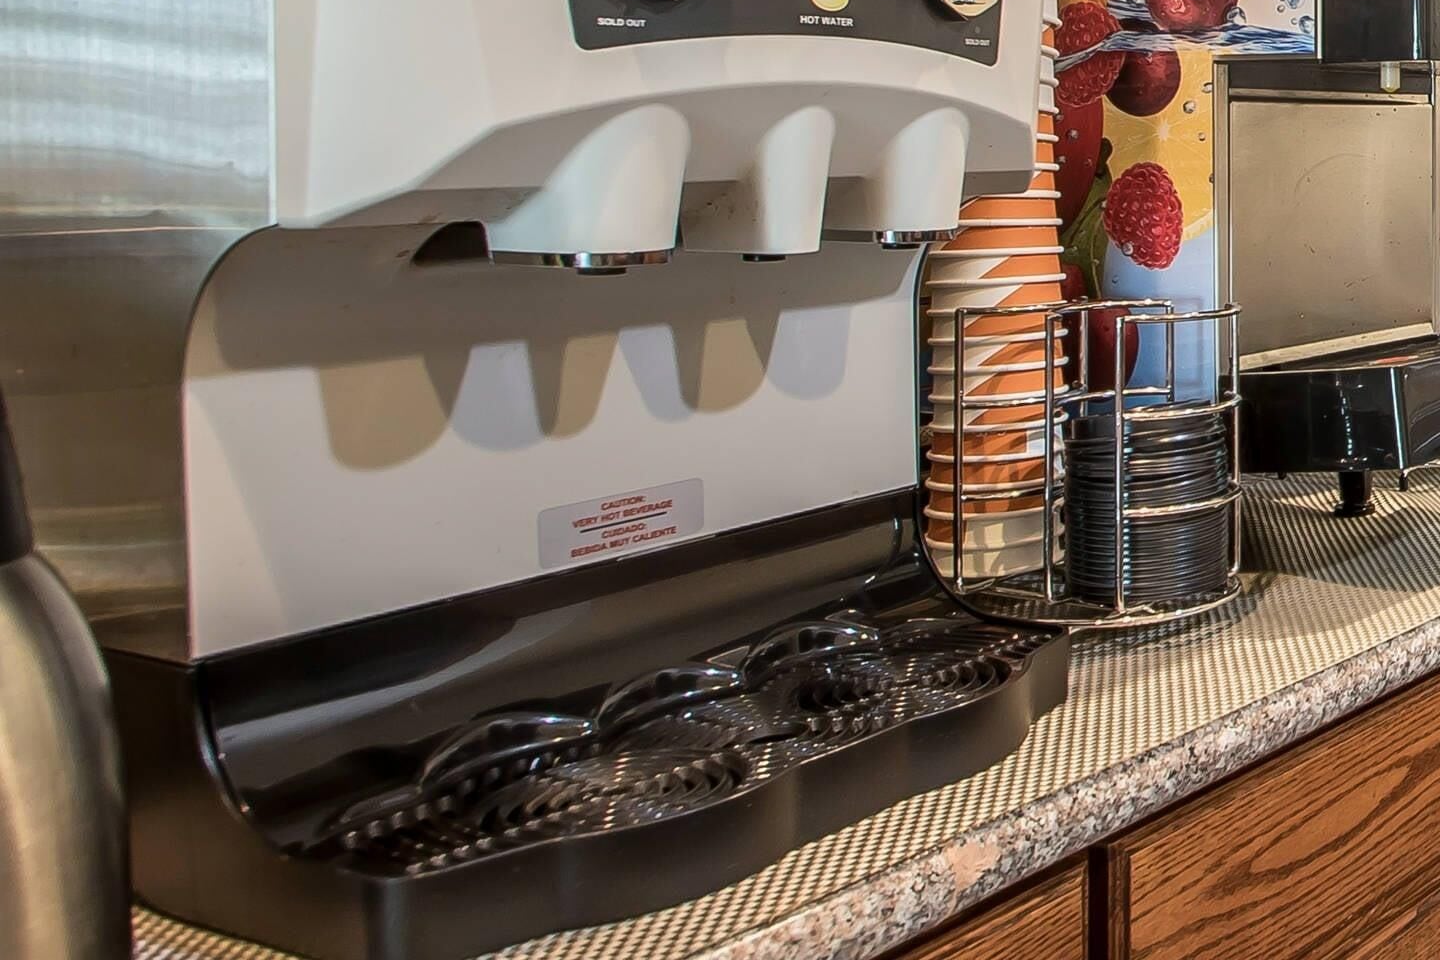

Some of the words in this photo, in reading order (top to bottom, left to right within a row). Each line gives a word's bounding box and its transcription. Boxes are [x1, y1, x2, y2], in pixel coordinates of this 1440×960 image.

[597, 17, 624, 26] SOLD
[626, 19, 646, 27] OUT
[800, 16, 820, 25] HOT
[821, 17, 854, 27] WATER
[601, 496, 646, 510] CAUTION:
[572, 516, 599, 528] VERY
[601, 513, 620, 522] HOT
[623, 500, 673, 517] BEVERAGE
[601, 523, 647, 539] CUIDADO:
[571, 543, 607, 558] BEBIDA
[609, 539, 631, 548] MUY
[633, 526, 677, 543] CALIENTE
